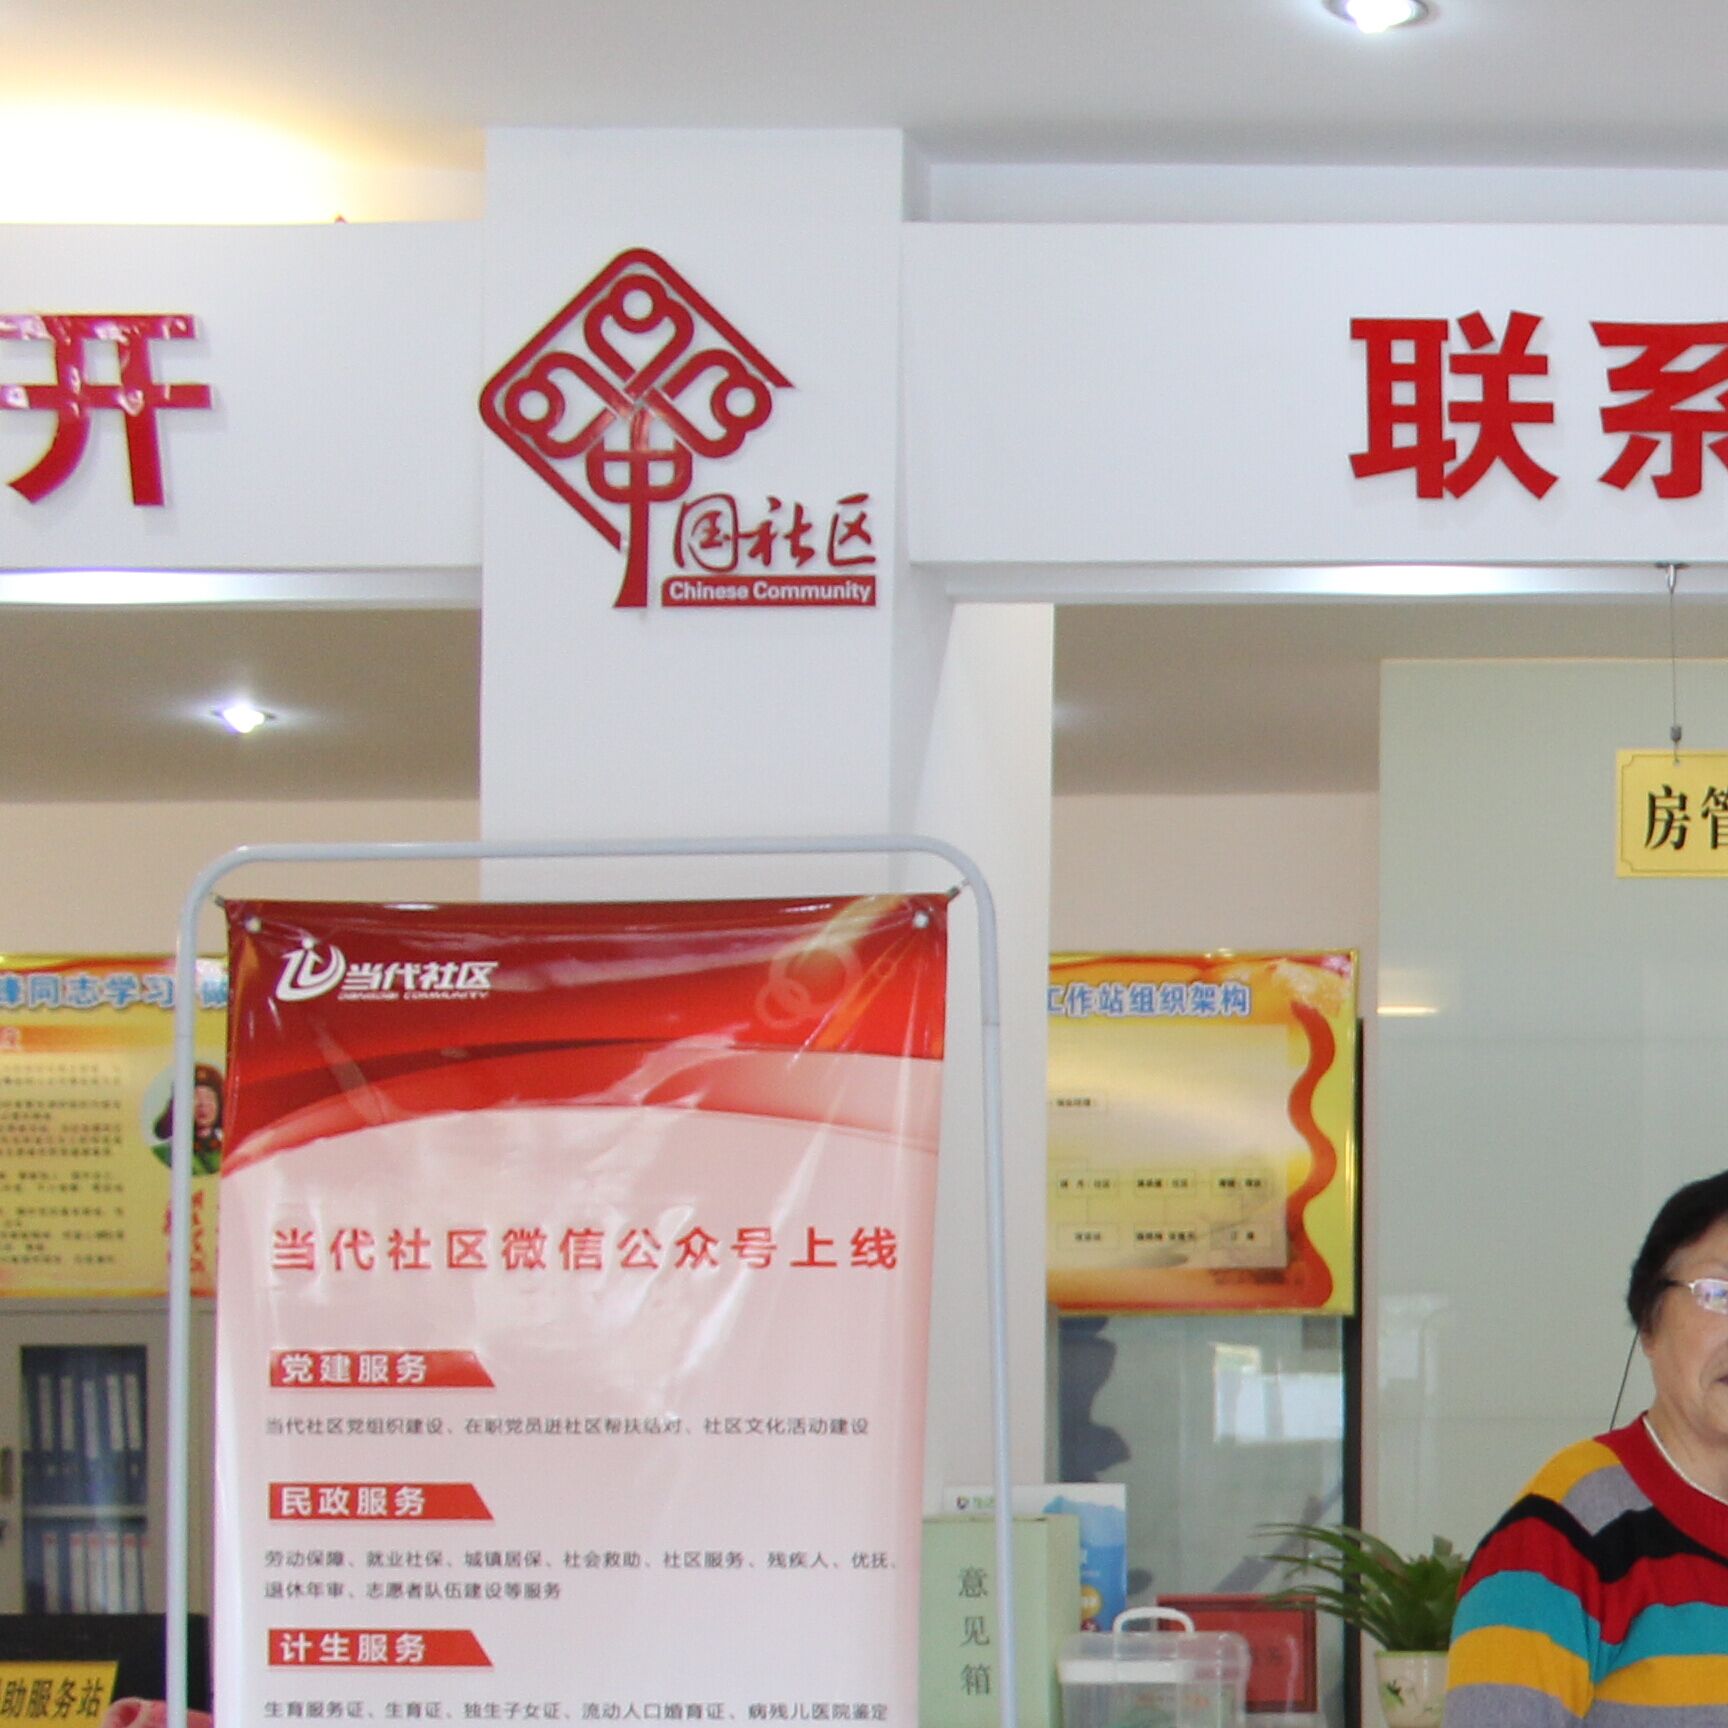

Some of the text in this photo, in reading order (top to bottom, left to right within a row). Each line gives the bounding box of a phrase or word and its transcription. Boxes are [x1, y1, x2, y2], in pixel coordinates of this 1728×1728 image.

[0, 313, 212, 507] 开
[669, 580, 872, 602] Chinese Community
[341, 962, 498, 990] 当代社区
[270, 1225, 900, 1273] 当代社区微信公众号上线
[281, 1352, 428, 1385] 党建服务
[280, 1485, 426, 1516] 民政服务
[958, 1564, 991, 1696] 意见箱
[280, 1631, 426, 1664] 计生服务
[0, 1676, 104, 1720] 助服务站
